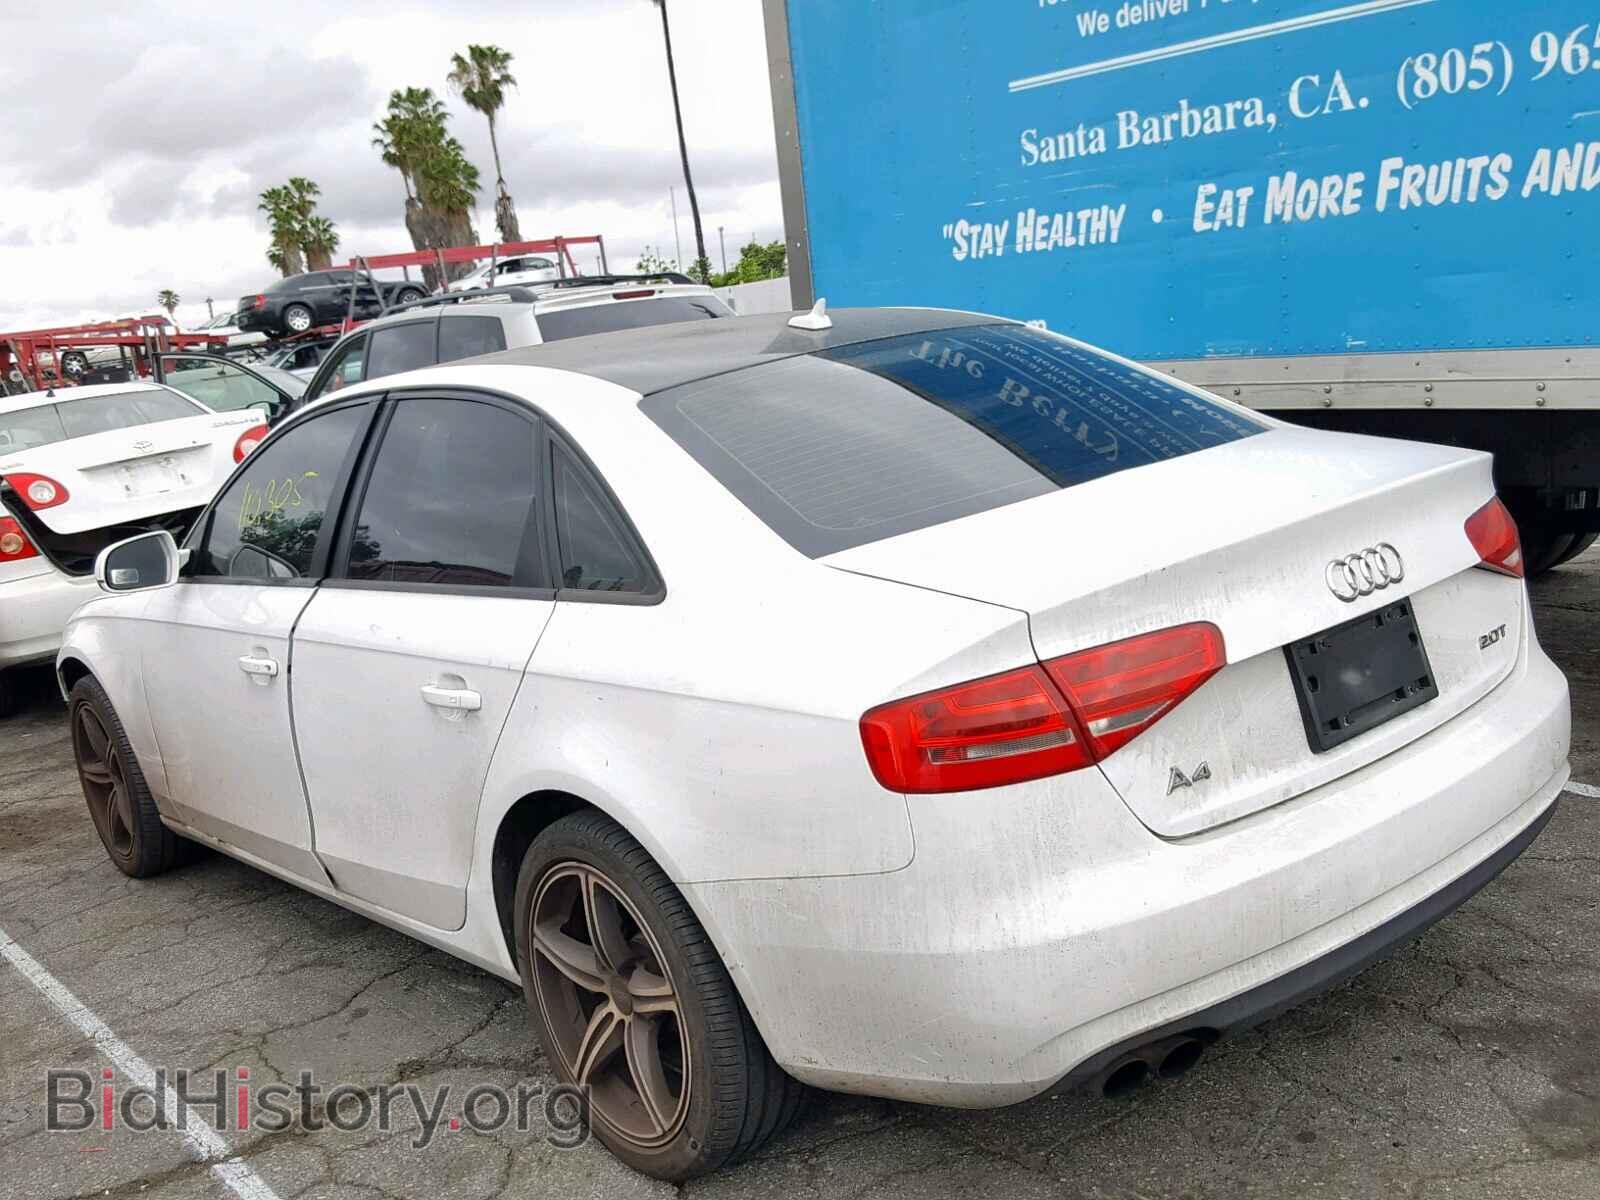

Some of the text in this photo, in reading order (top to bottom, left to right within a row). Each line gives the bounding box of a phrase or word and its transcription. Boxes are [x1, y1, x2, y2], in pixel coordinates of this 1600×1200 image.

[1076, 9, 1110, 38] We
[1020, 123, 1107, 167] Santa
[1116, 97, 1278, 149] Barbara,
[1288, 69, 1370, 119] CA.
[1396, 40, 1513, 110] (805)
[1015, 203, 1127, 254] HEALTHY
[1193, 183, 1255, 233] EAT
[1263, 170, 1366, 225] MORE
[1375, 152, 1513, 213] FRUITS
[1166, 760, 1211, 796] A4
